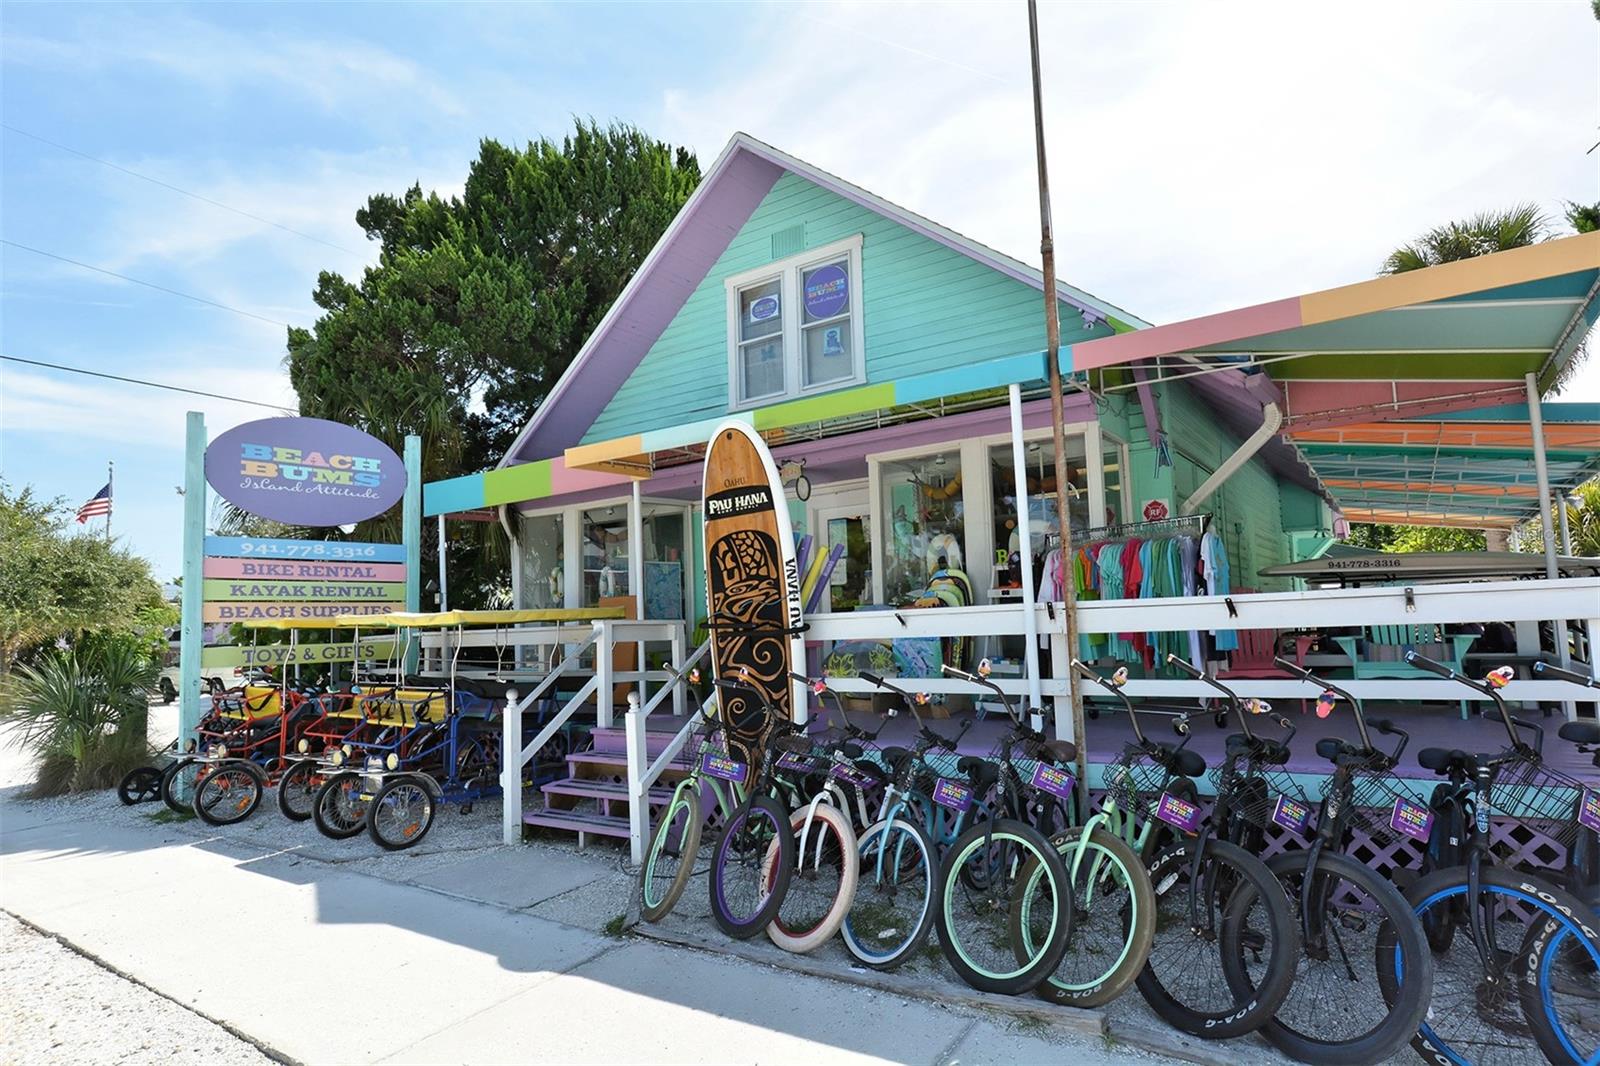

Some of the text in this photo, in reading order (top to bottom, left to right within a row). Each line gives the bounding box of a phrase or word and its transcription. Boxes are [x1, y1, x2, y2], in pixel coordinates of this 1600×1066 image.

[240, 443, 381, 473] BEACH
[240, 460, 382, 487] BUMS
[240, 477, 380, 500] Island Attitude
[708, 498, 733, 514] PAU
[735, 492, 769, 508] HANA
[240, 543, 376, 558] 941.778.3316
[241, 563, 377, 578] BIKE RENTAL
[785, 557, 799, 602] HANA
[229, 584, 388, 597] KAYAK RENTAL
[218, 605, 392, 618] BEACH SUPPLIES
[241, 645, 375, 664] TOYS & GIFTS
[1520, 882, 1598, 938] BOA-G
[1526, 919, 1557, 986] BOA-G
